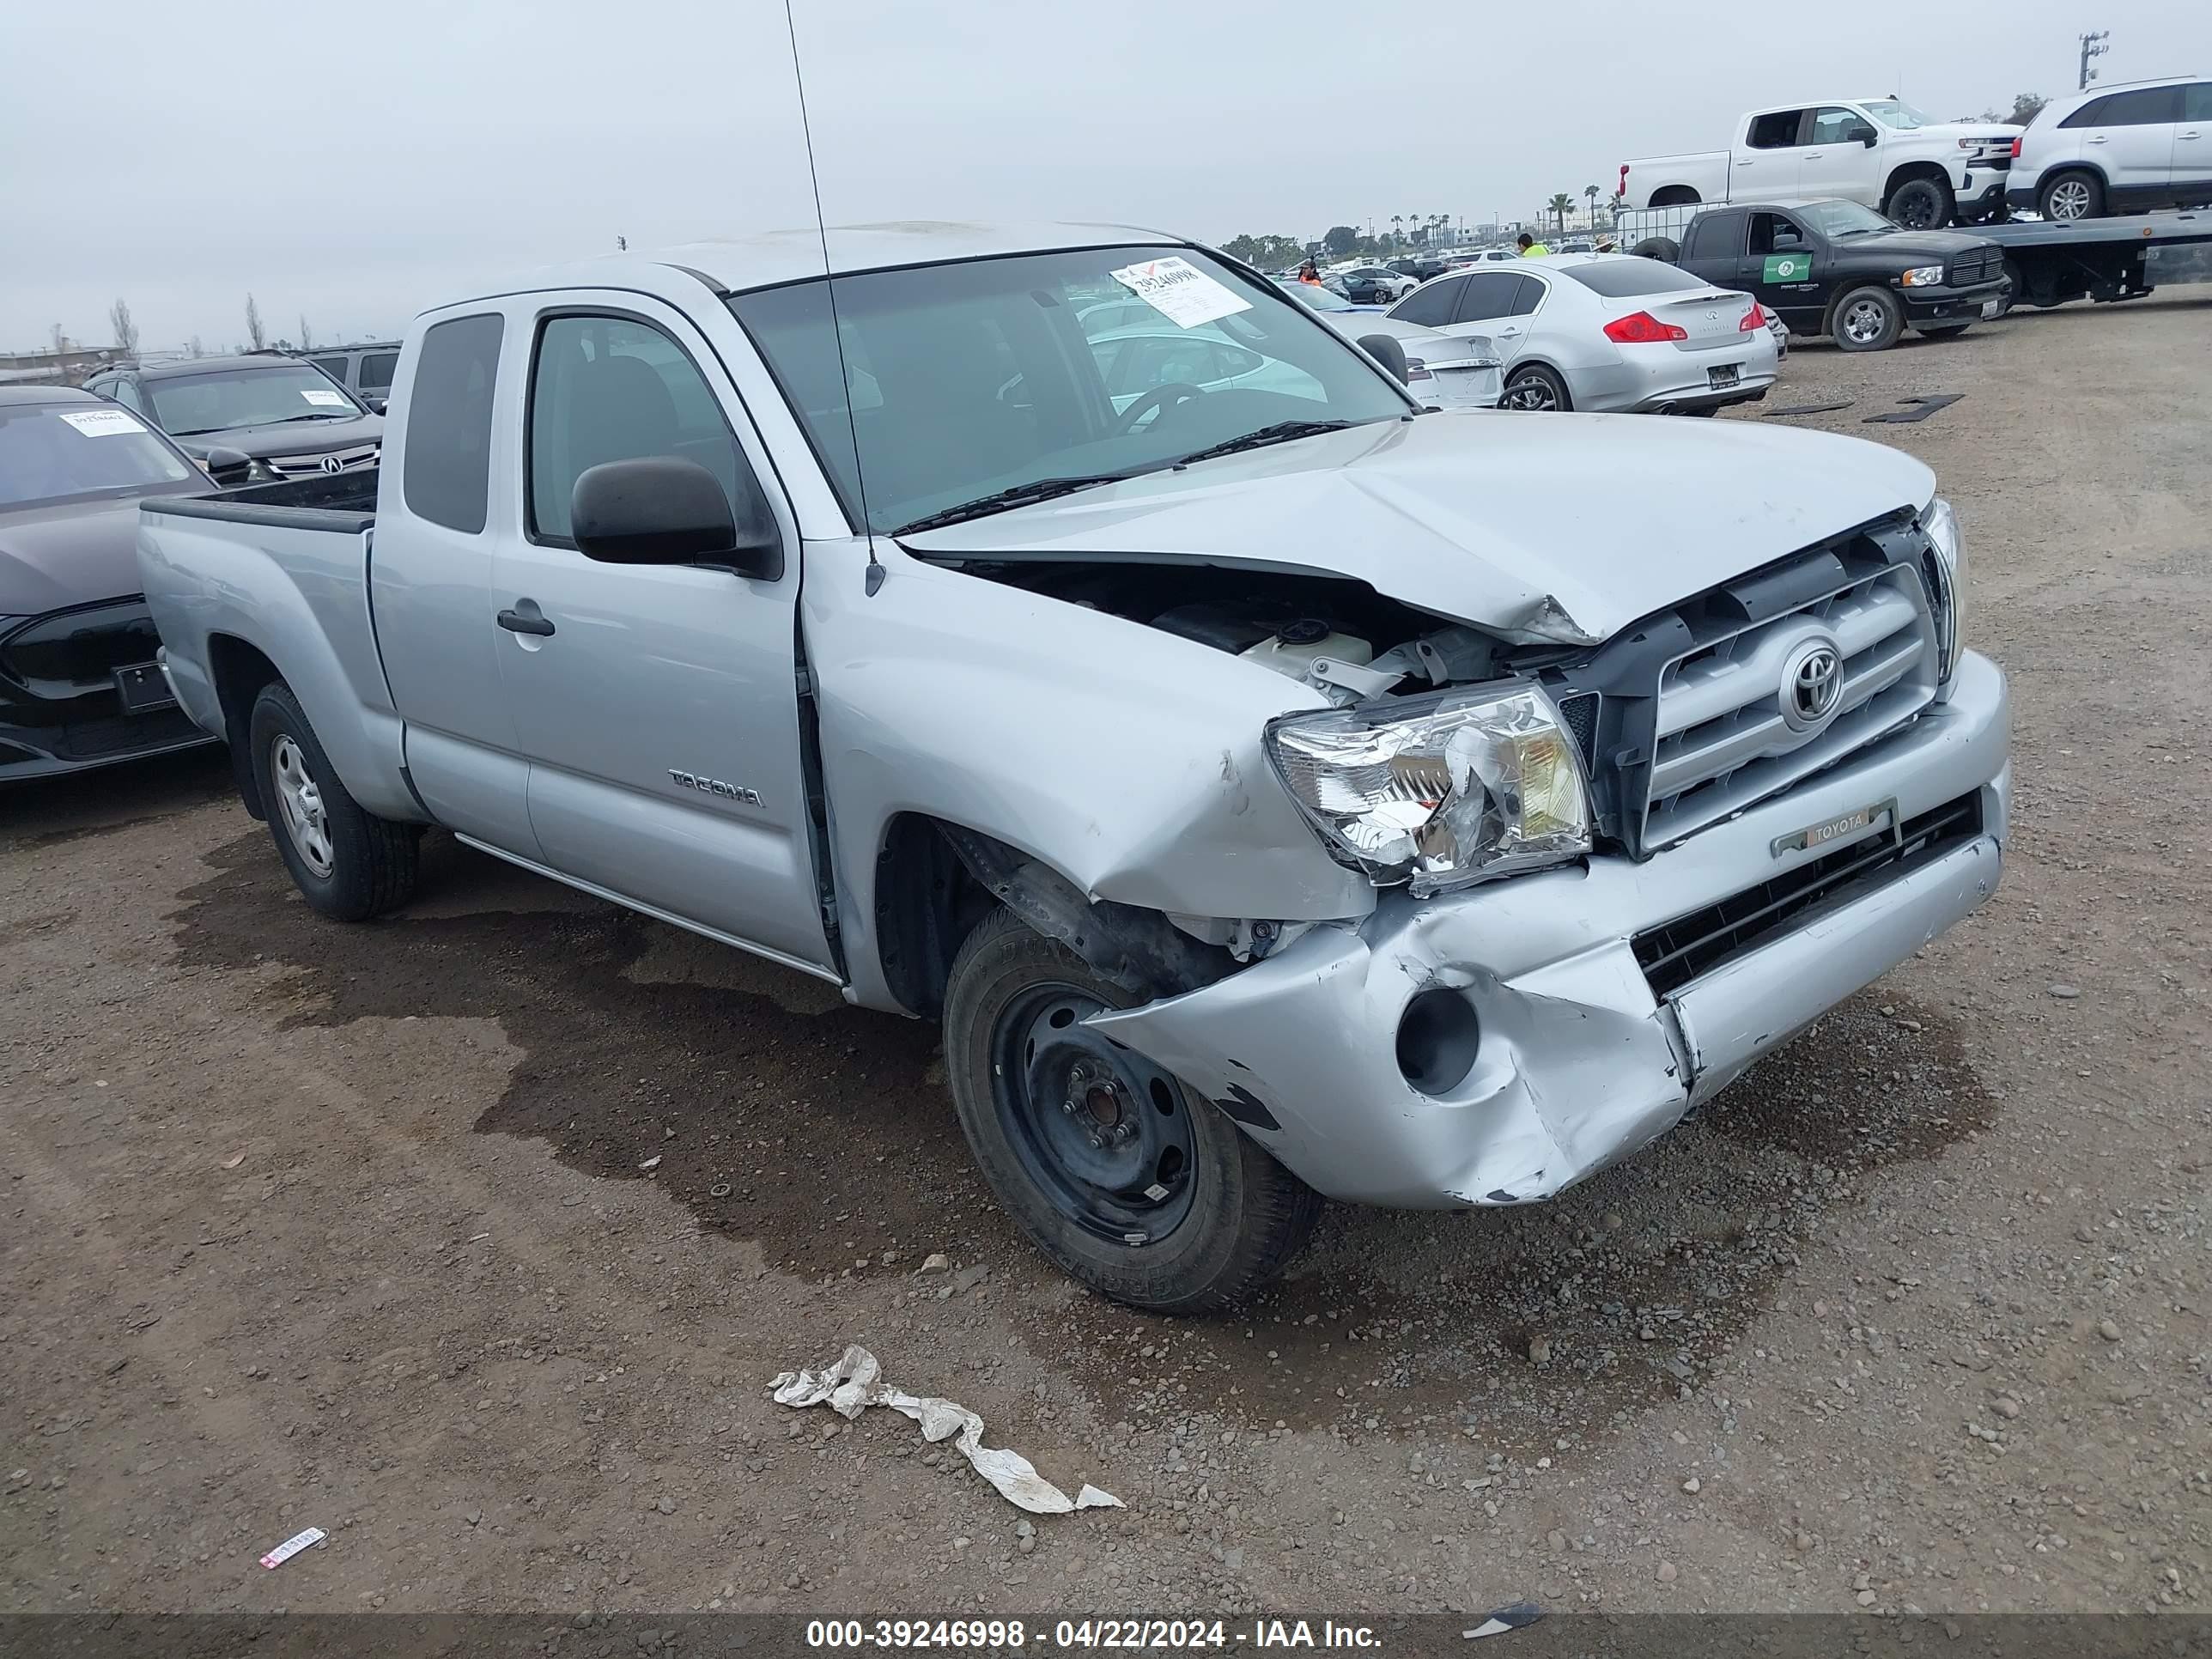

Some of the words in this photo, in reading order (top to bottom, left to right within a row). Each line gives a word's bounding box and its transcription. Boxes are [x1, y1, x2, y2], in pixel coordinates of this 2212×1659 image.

[1135, 269, 1199, 293] 39246998
[667, 769, 766, 808] TACOMA
[1815, 814, 1863, 842] TOYOTA
